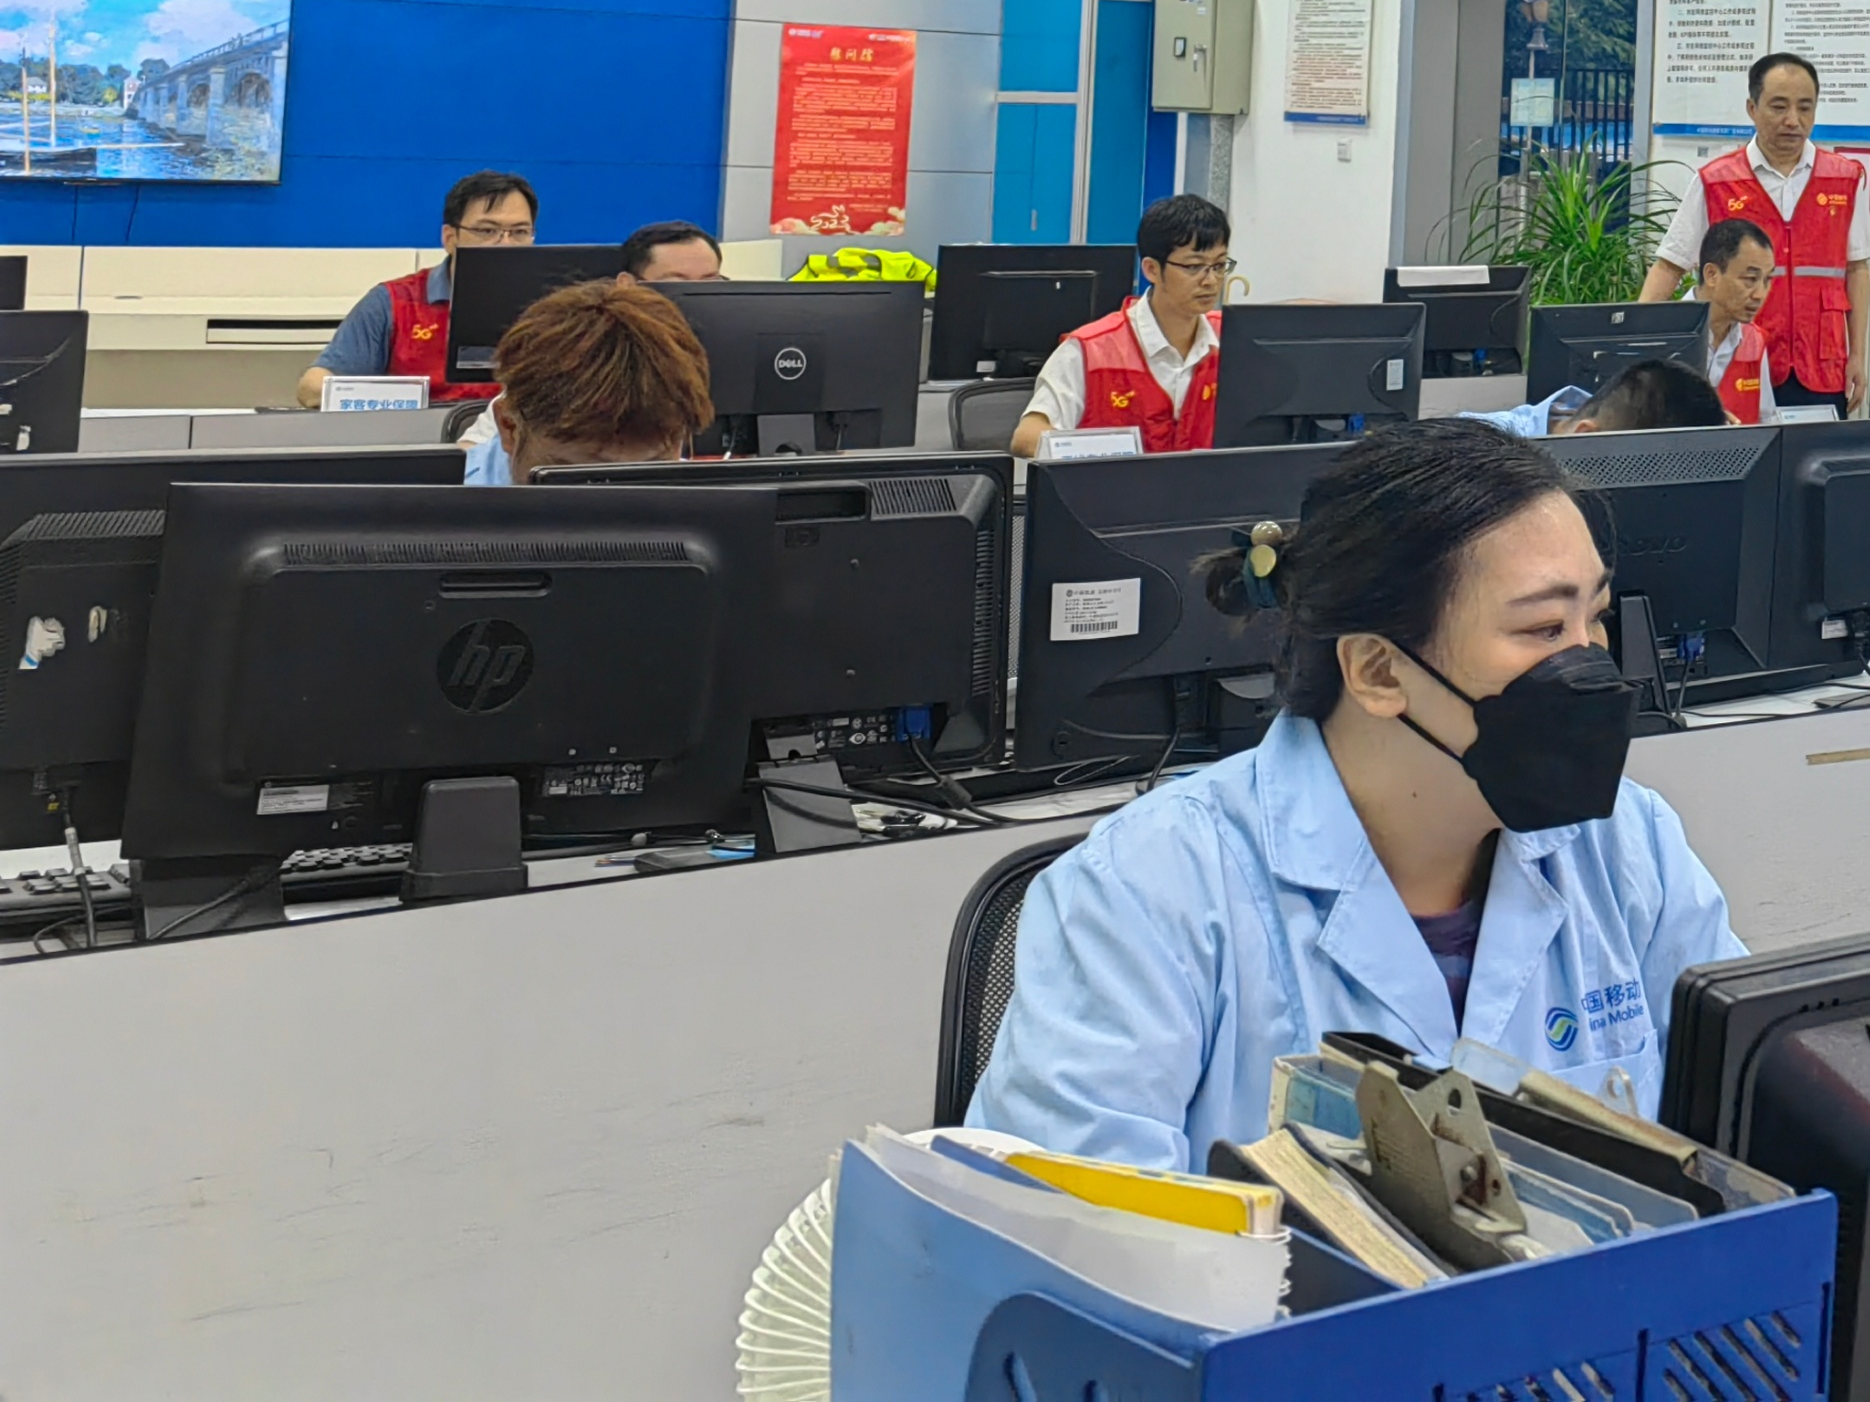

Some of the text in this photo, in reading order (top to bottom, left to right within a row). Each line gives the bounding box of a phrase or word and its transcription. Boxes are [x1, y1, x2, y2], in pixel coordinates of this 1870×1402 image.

[412, 323, 435, 340] 5G
[445, 619, 527, 712] hp
[1589, 1003, 1644, 1031] ina Mobile
